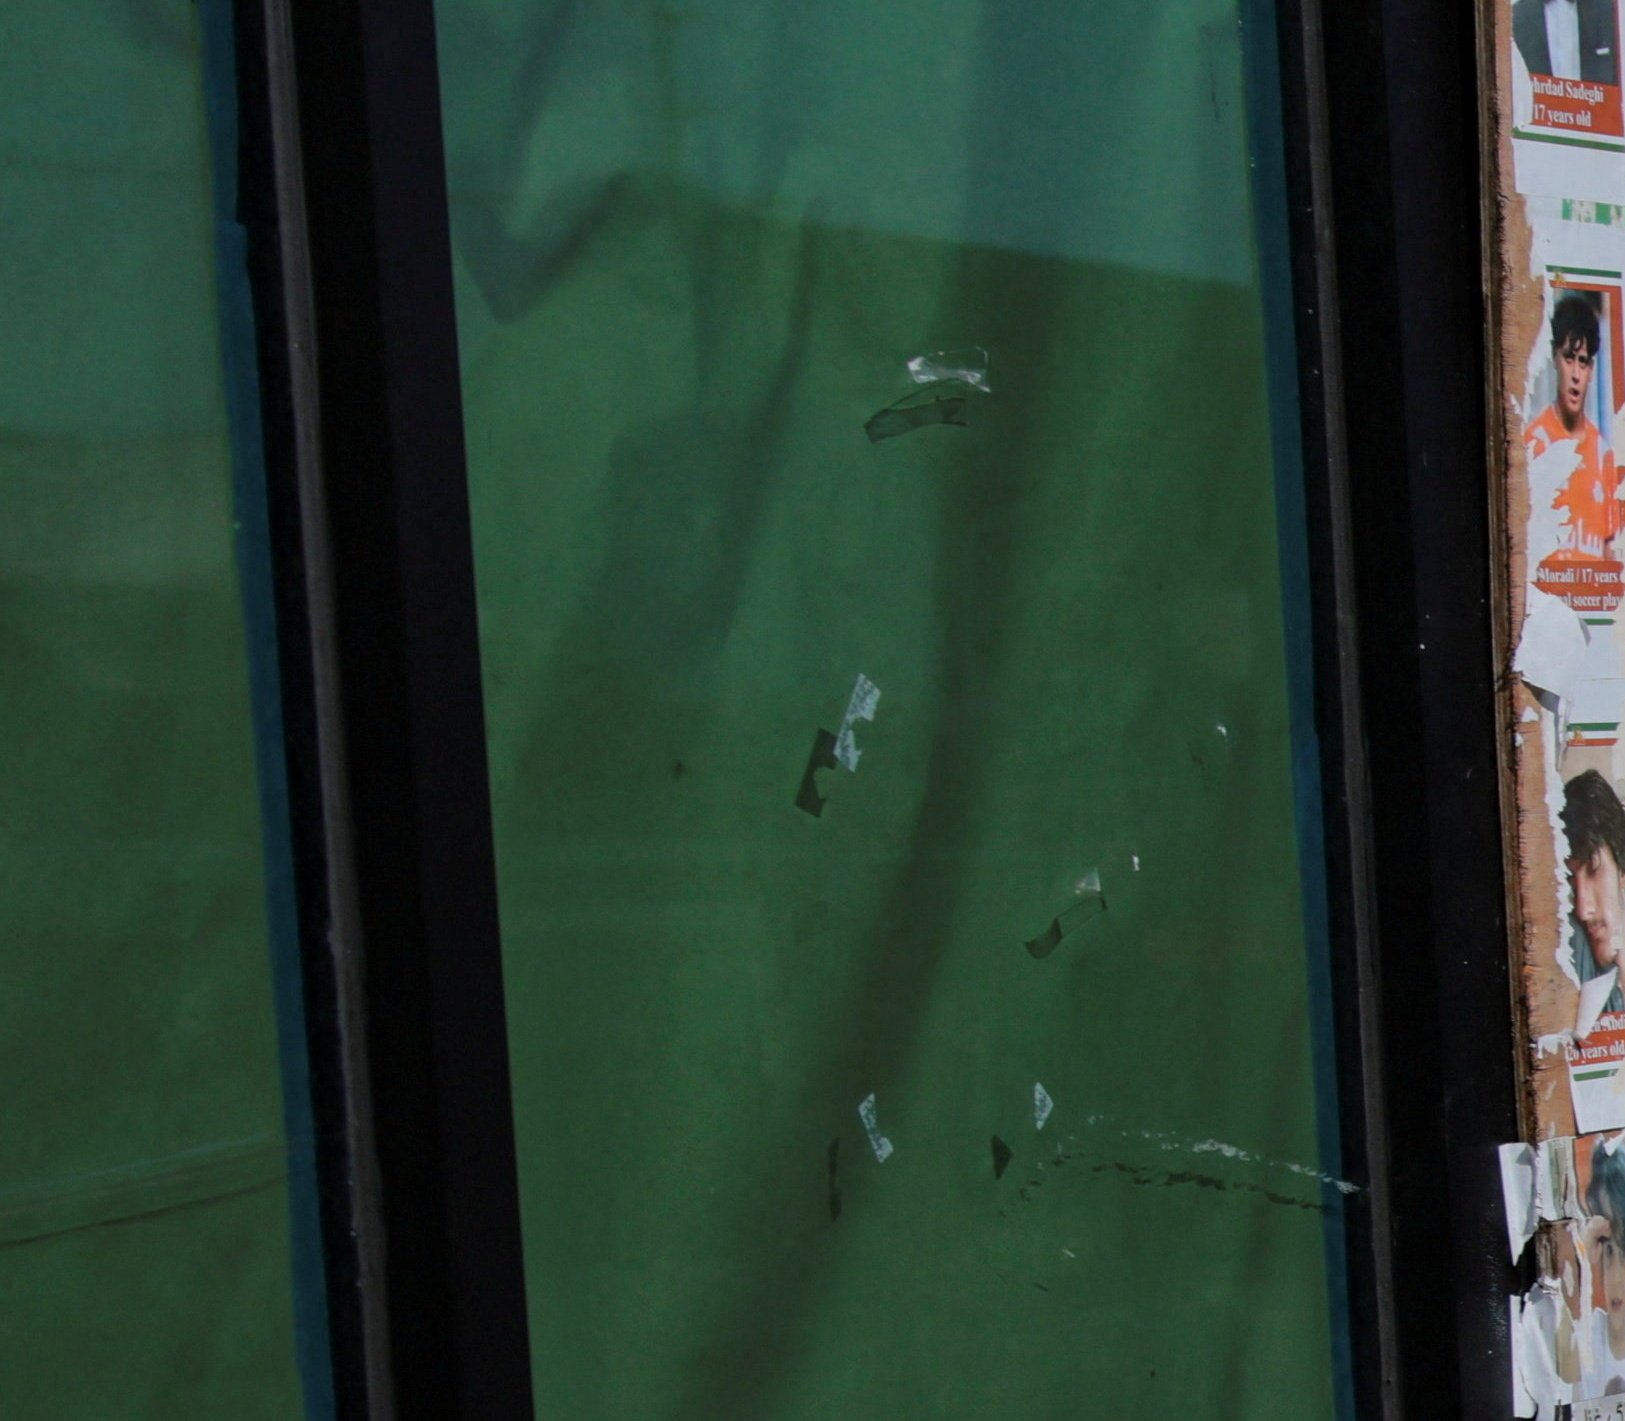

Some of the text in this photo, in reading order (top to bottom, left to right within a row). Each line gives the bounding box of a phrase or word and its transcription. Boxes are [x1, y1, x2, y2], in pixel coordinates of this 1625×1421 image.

[1533, 76, 1605, 107] hrdad Sadeghi
[1533, 104, 1593, 128] 17 years old
[1594, 570, 1619, 588] years
[1572, 593, 1602, 608] soccer
[1580, 1045, 1609, 1064] years
[1609, 1039, 1625, 1057] old
